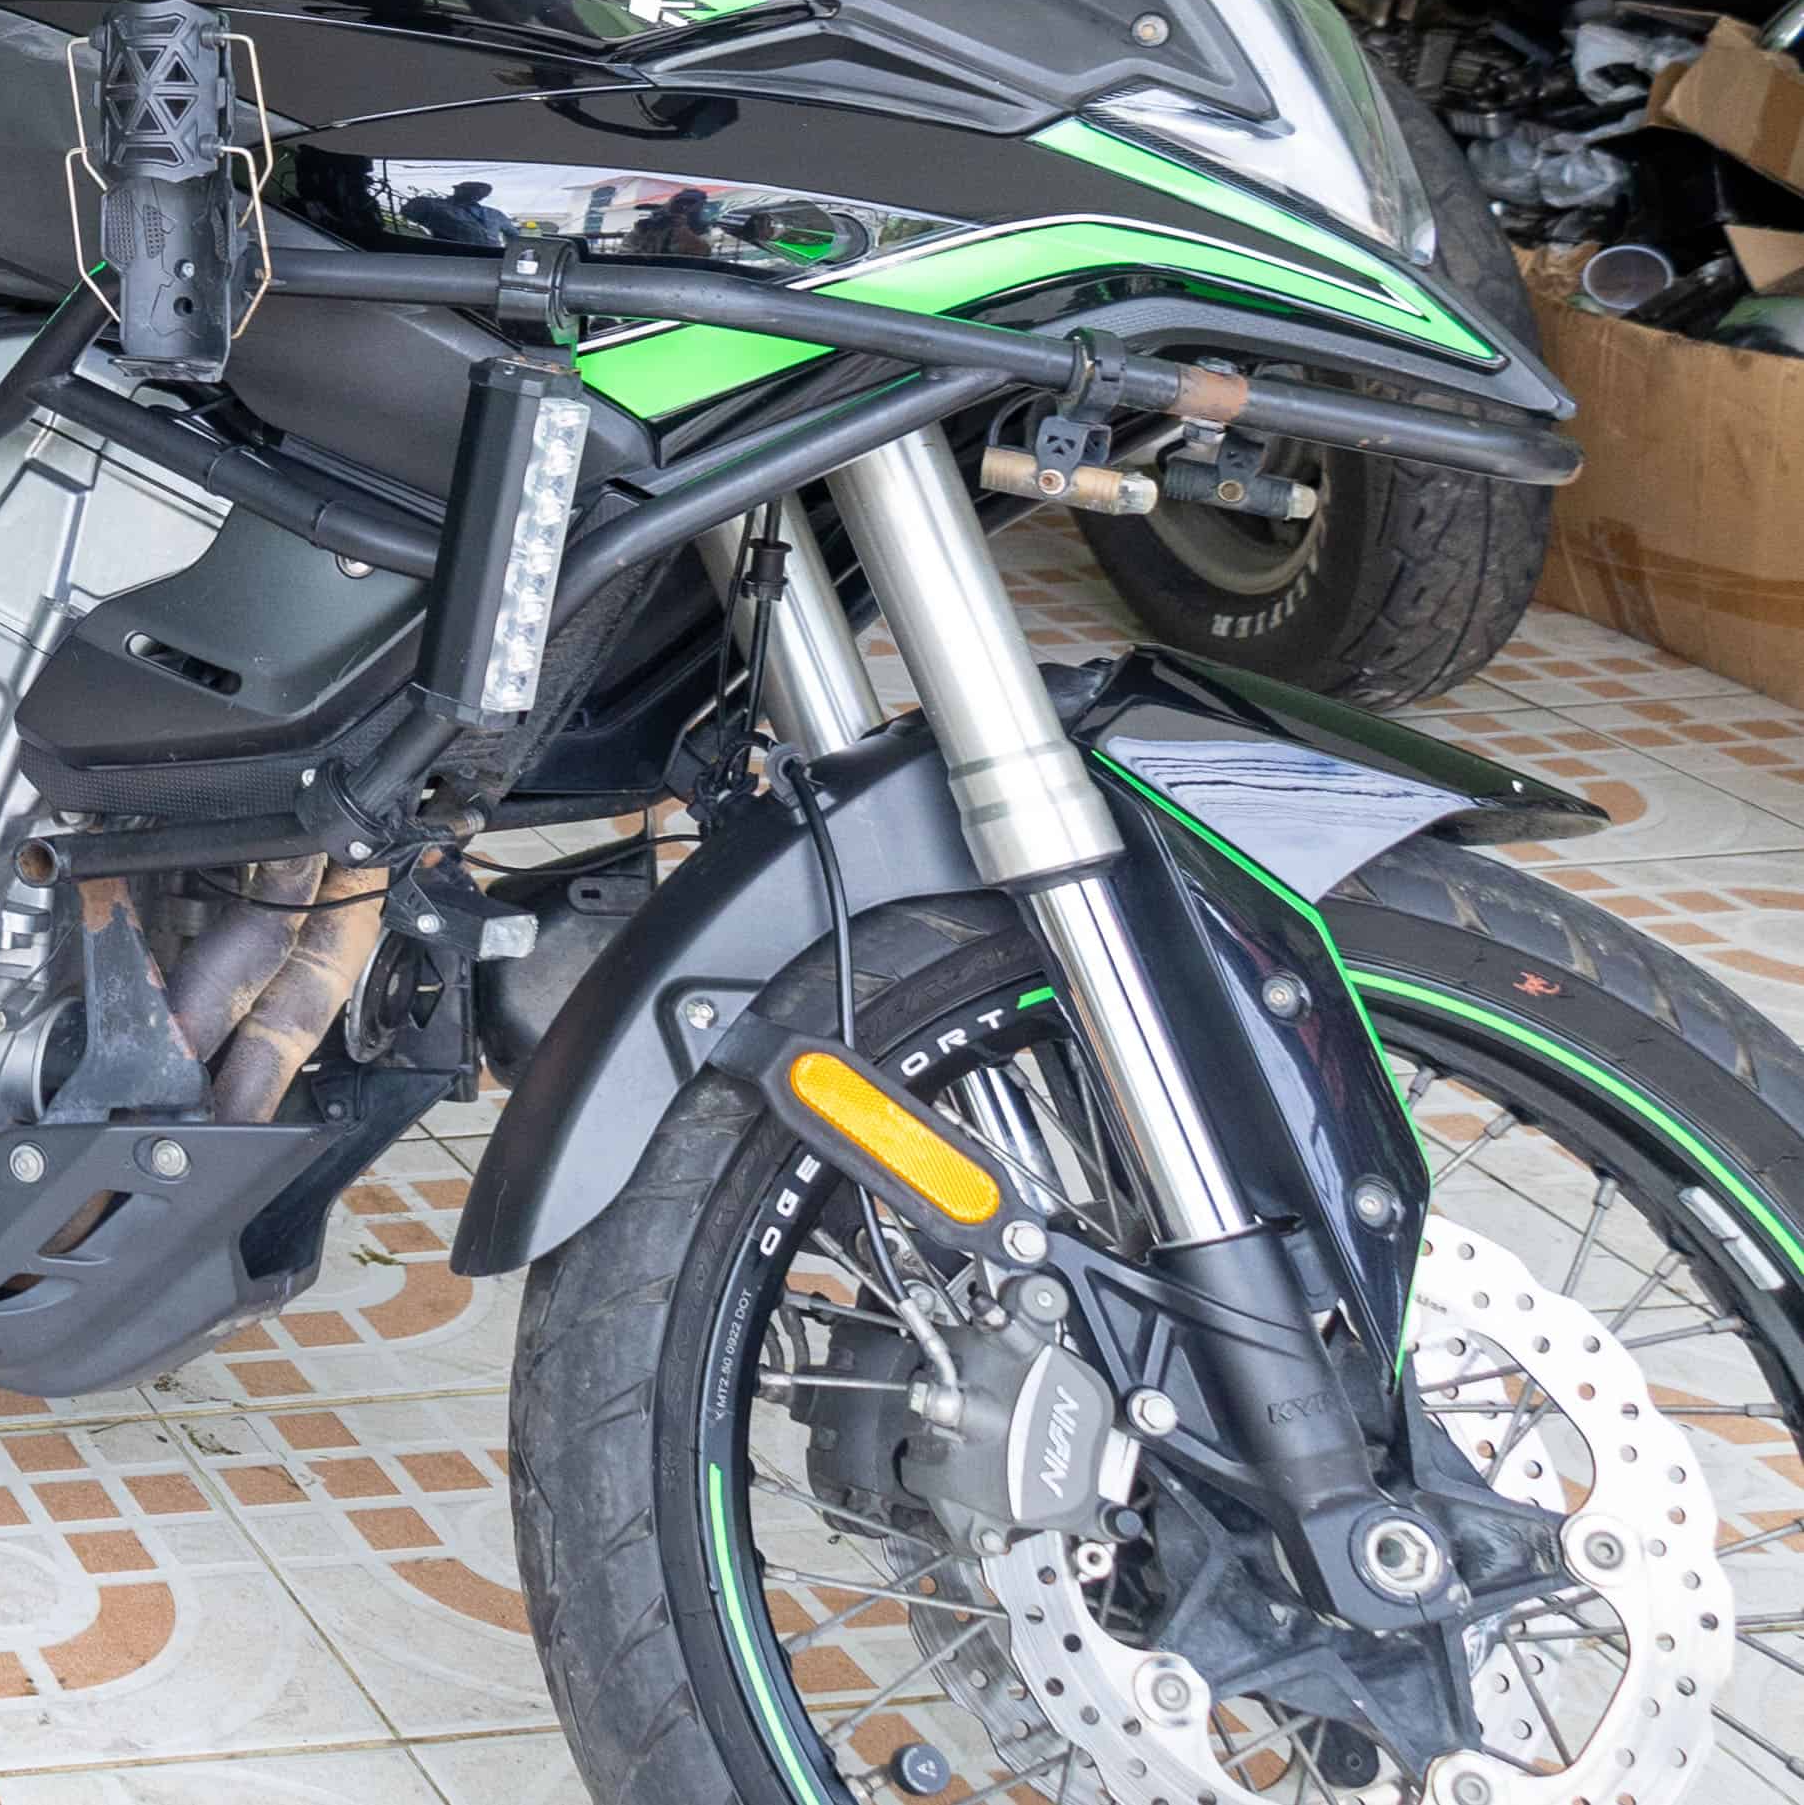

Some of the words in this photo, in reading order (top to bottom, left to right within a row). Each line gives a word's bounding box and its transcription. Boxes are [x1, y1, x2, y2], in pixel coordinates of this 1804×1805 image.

[900, 1007, 1004, 1077] ORT
[733, 1288, 752, 1320] DOT
[1039, 1384, 1080, 1499] NISSIN
